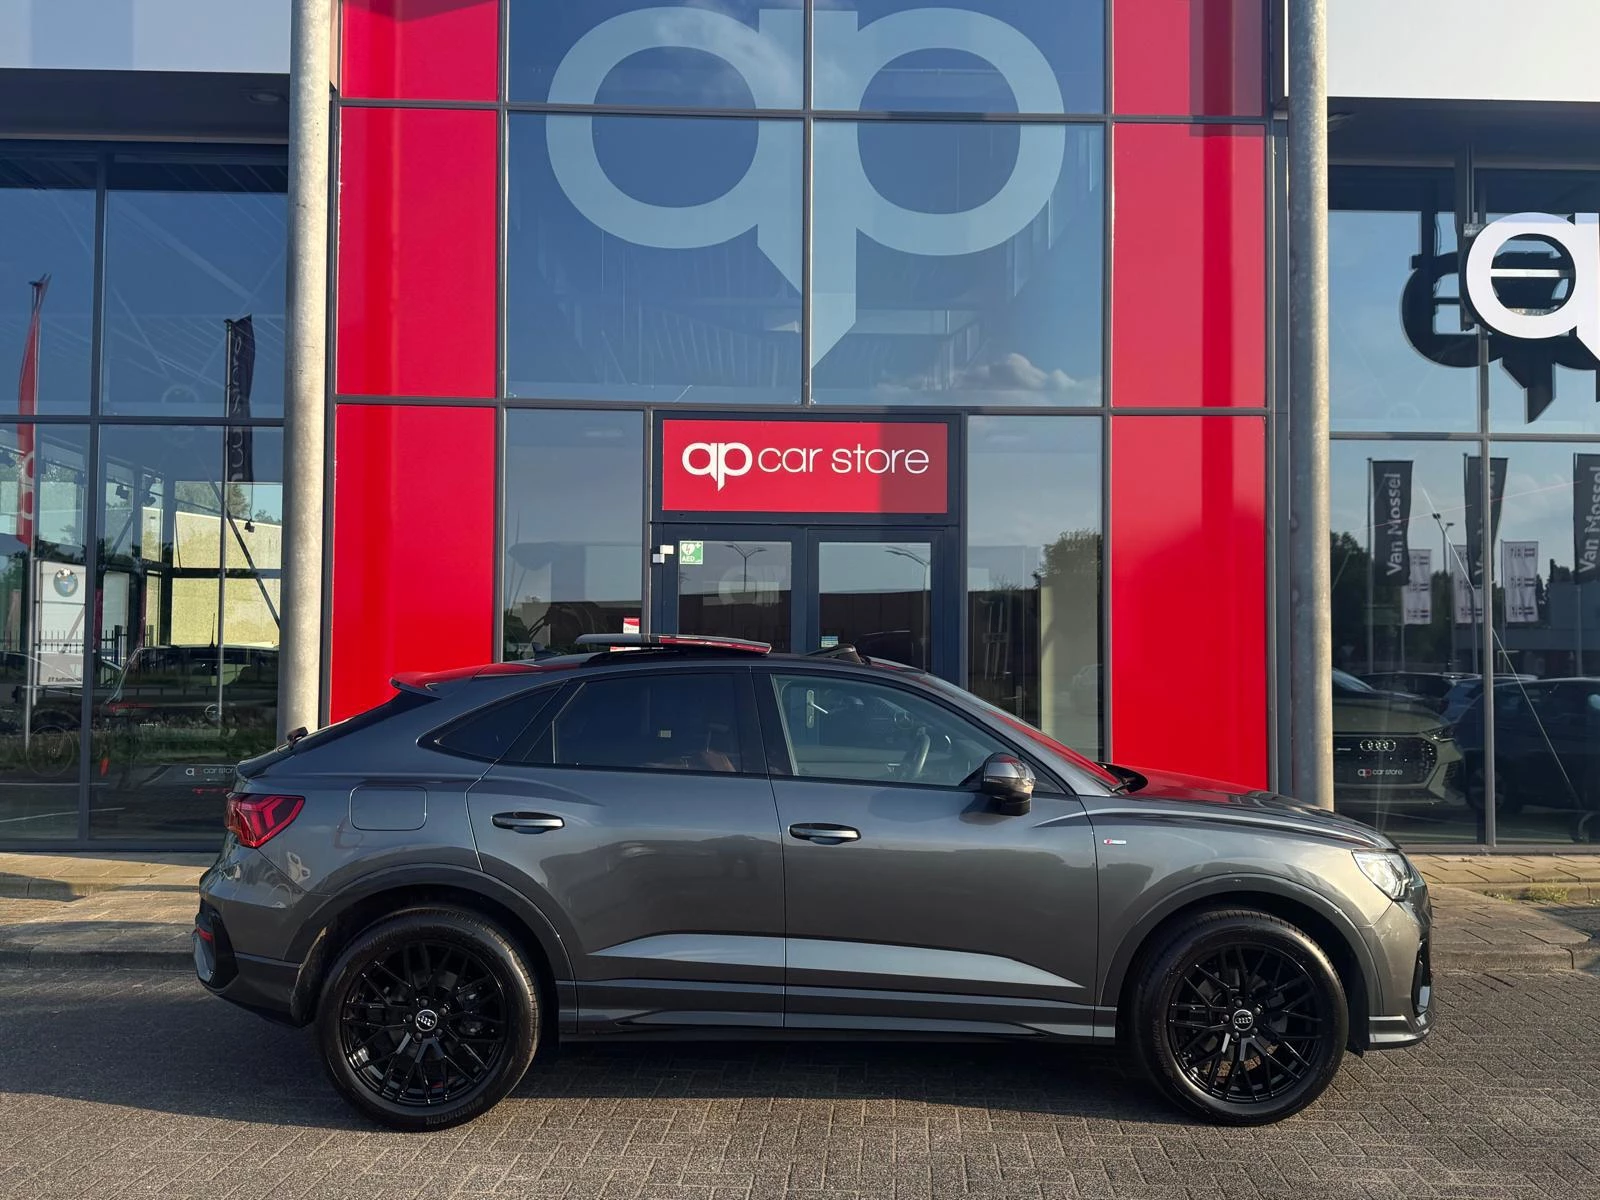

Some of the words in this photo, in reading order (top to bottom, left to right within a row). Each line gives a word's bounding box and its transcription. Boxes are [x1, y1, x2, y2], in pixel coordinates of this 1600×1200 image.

[546, 6, 1066, 370] ap
[1466, 212, 1600, 364] a
[682, 442, 753, 491] ap
[758, 447, 823, 473] car
[831, 443, 929, 475] store
[1384, 473, 1402, 535] Mossel
[1386, 541, 1402, 576] Van
[1578, 540, 1600, 573] Van
